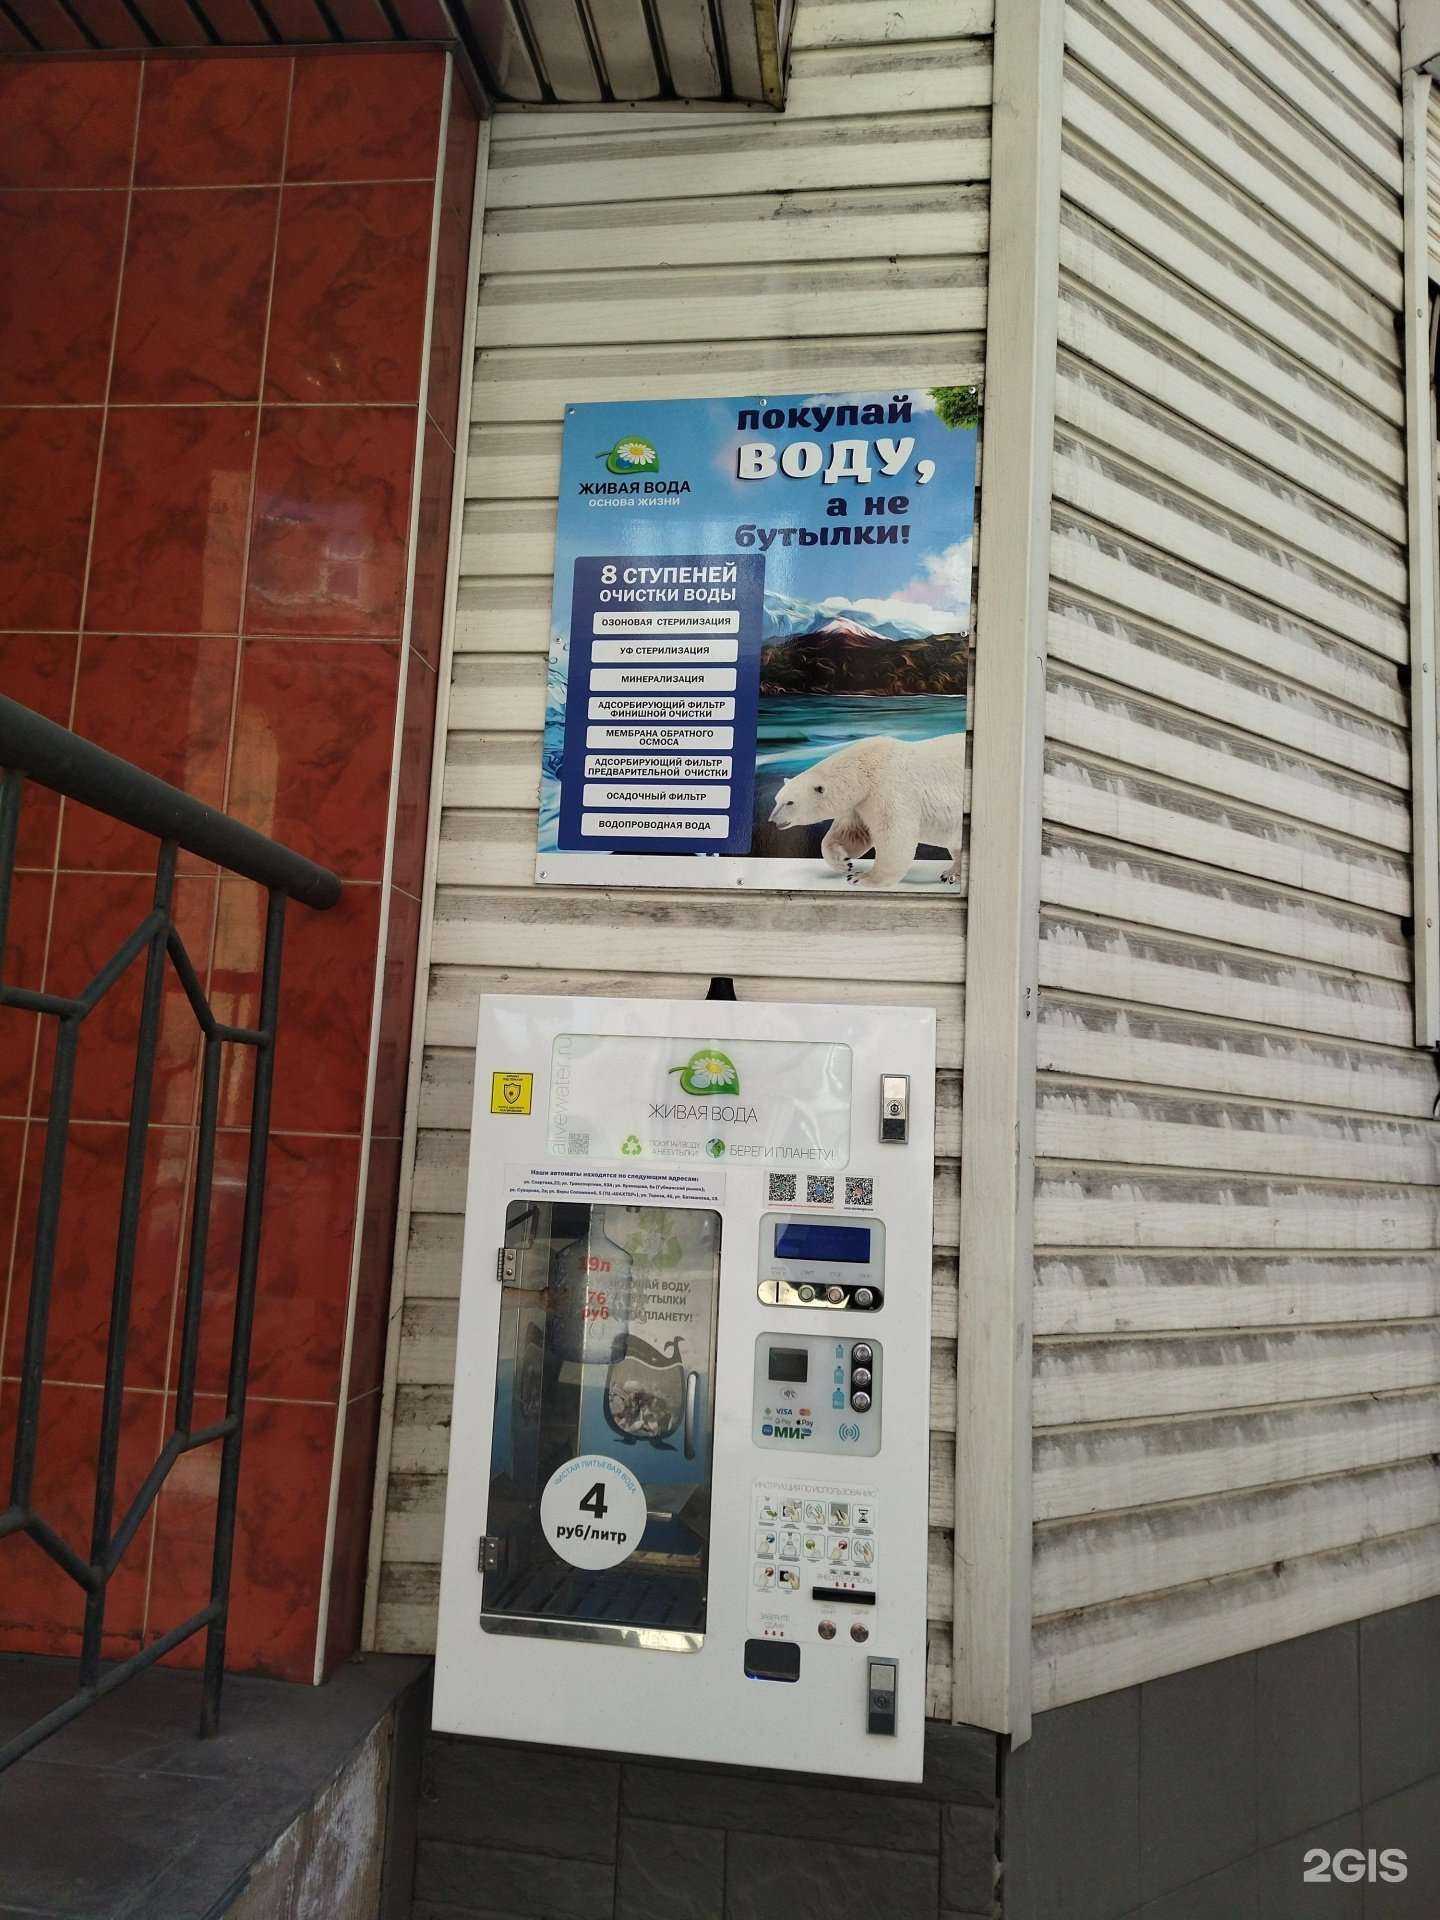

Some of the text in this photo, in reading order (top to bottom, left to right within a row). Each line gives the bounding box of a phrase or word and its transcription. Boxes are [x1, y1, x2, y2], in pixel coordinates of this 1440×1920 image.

[737, 395, 912, 433] покупай
[737, 437, 937, 485] ВОДУ,
[578, 480, 691, 495] ЖИВАЯ ВОДА
[588, 496, 680, 508] основа жизни
[827, 495, 910, 517] а не
[735, 523, 910, 551] бутылки!
[601, 562, 737, 585] 8 СТУПЕНЕЙ
[600, 587, 736, 603] ОЧИСТКИ ВОДЫ
[601, 617, 731, 626] ОЗОНОВАЯ СТЕРИЛИЗАЦИЯ
[620, 646, 710, 655] УФ СТЕРИЛИЗАЦИЯ
[621, 675, 705, 684] МИНЕРАЛИЗАЦИЯ
[598, 700, 726, 710] АДСОРБИРУЮЩИЙ ФИЛЬТР
[610, 708, 712, 718] ФИНИШНОЙ ОЧИСТКИ
[606, 729, 714, 738] МЕМБРАНА ОБРАТНОГО
[639, 738, 679, 746] ОСМОСА
[595, 758, 723, 767] АДСОРБИРУЮЩИЙ ФИЛЬТР
[588, 767, 728, 777] ПРЕДВАРИТЕЛЬНОЙ ОЧИСТКИ
[606, 791, 707, 801] ОСАДОЧНЫЙ ФИЛЬТР
[599, 820, 711, 830] ВОДОПРОВОДНАЯ ВОДА
[648, 1103, 758, 1124] ЖИВАЯ ВОДА
[729, 1144, 774, 1158] БЕРЕГИ
[531, 1169, 549, 1177] Наши
[550, 1170, 582, 1178] автоматы
[662, 1281, 692, 1293] ВОДУ,
[588, 1291, 606, 1304] 76
[580, 1306, 609, 1321] руб
[644, 1311, 693, 1322] ПЛАНЕТУ!
[774, 1426, 811, 1440] МИР
[579, 1482, 608, 1519] 4
[556, 1524, 627, 1544] руб/литр
